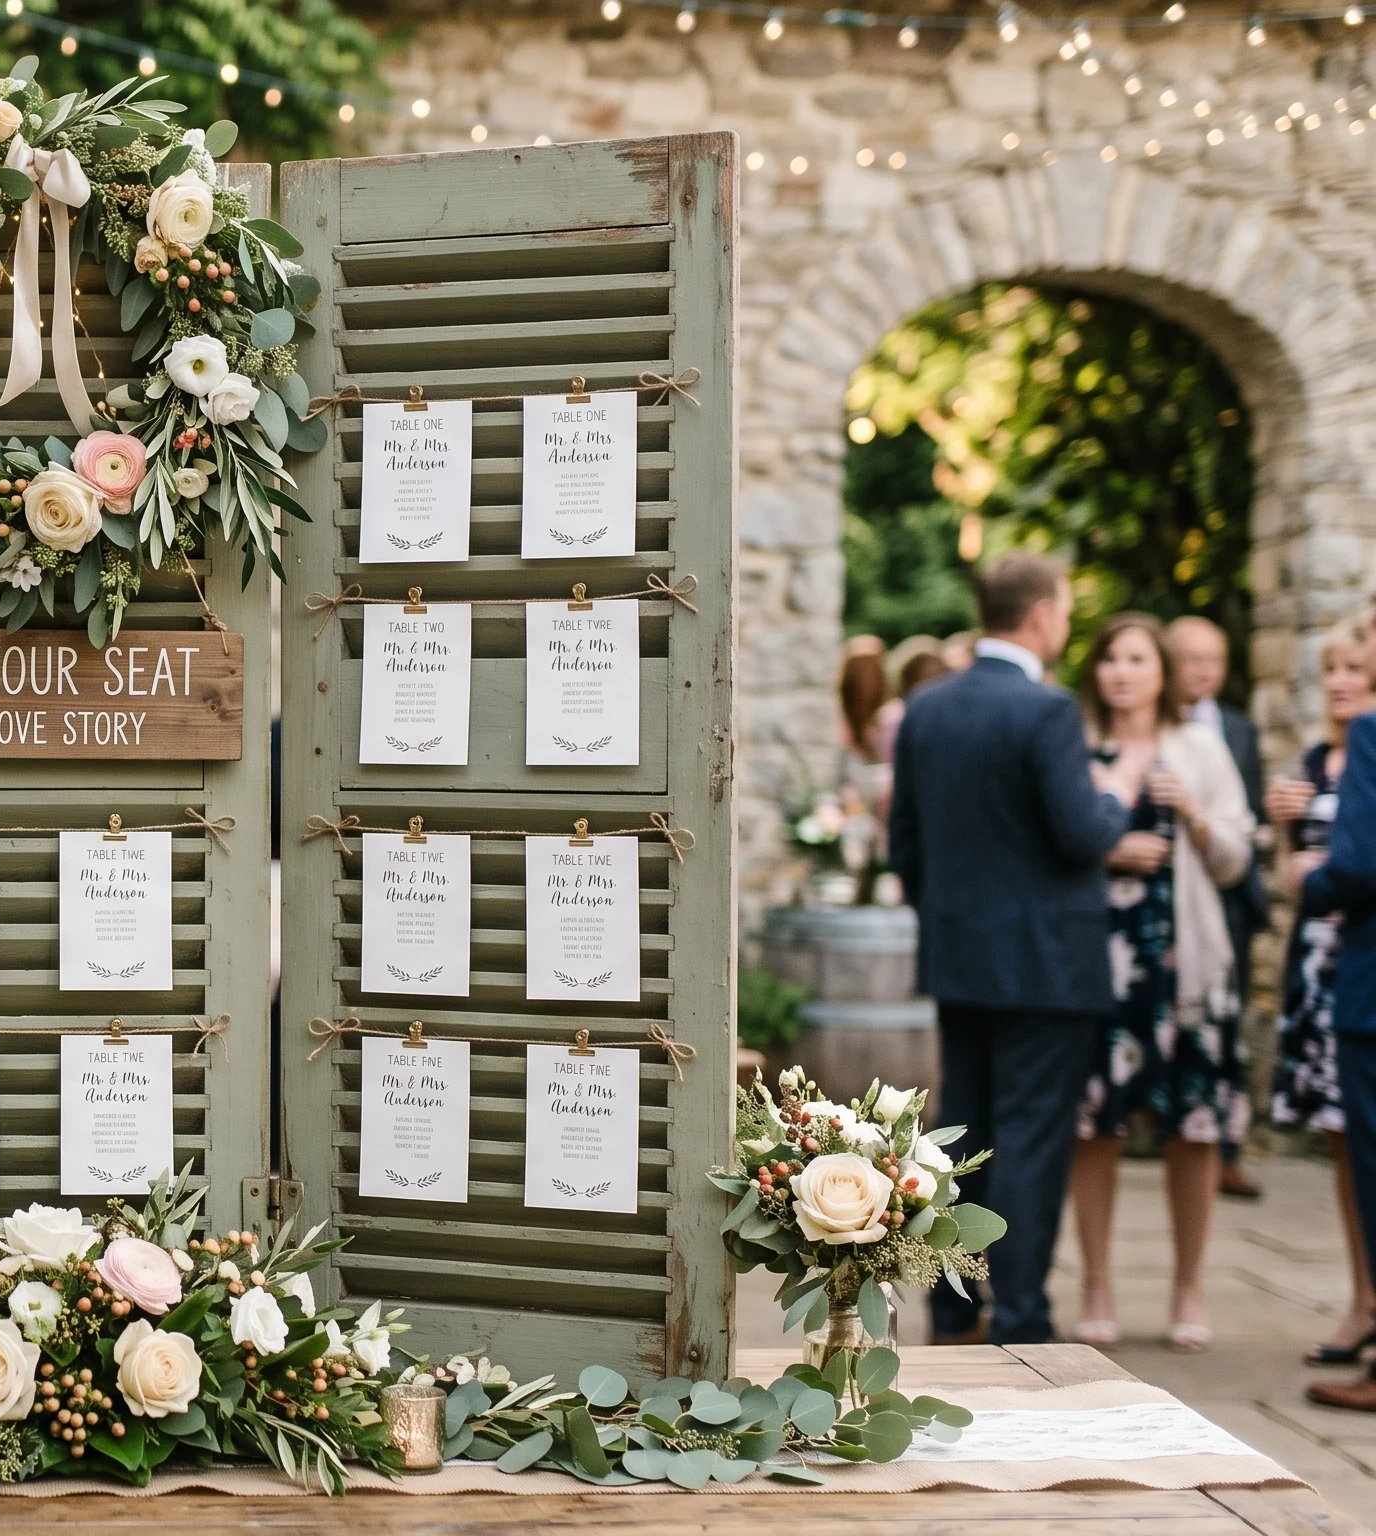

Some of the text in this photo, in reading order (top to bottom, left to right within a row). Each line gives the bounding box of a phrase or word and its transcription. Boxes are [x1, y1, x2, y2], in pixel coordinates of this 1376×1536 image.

[552, 410, 606, 423] TABLE ONE
[390, 418, 443, 430] TABLE ONE
[388, 622, 444, 633] TABLE TWO
[552, 620, 582, 631] TABLE
[103, 647, 200, 697] SEAT
[63, 711, 146, 746] STORY
[86, 850, 116, 860] TABLE
[387, 851, 416, 862] TABLE
[552, 854, 583, 865] TABLE
[88, 1053, 118, 1063] TABLE
[388, 1055, 417, 1066] TABLE
[554, 1063, 584, 1075] TABLE
